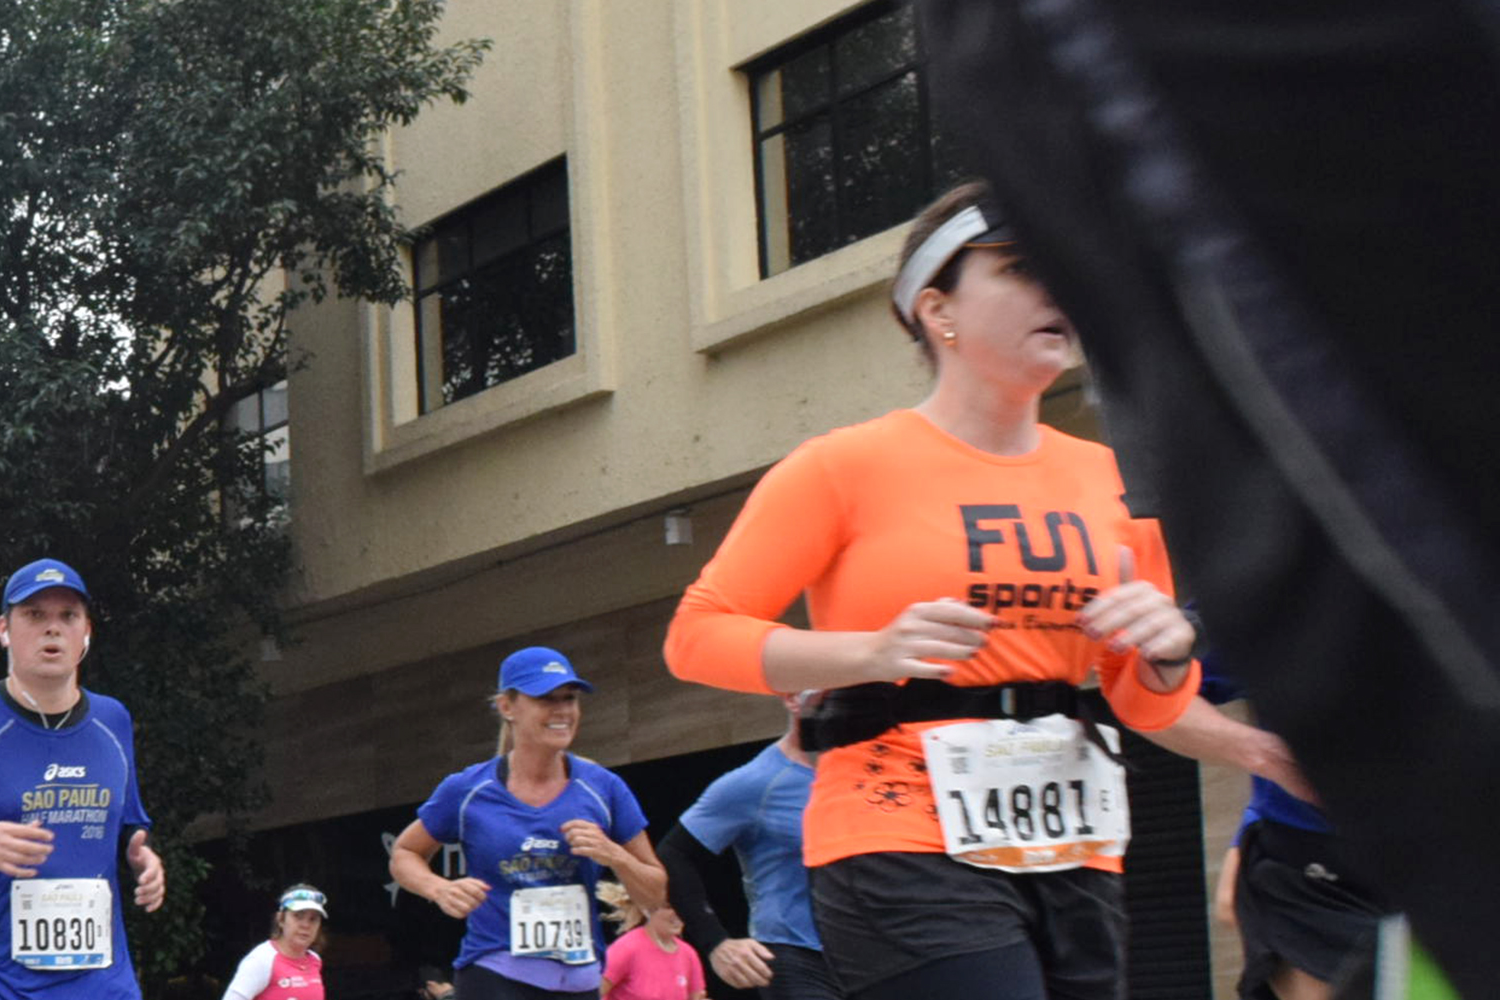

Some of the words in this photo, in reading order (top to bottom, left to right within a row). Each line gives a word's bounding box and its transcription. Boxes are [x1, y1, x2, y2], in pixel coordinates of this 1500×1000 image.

[59, 787, 111, 808] PAULO
[947, 779, 1094, 845] 14881
[47, 809, 109, 824] MARATHON
[17, 917, 95, 952] 10830
[518, 919, 583, 950] 10739
